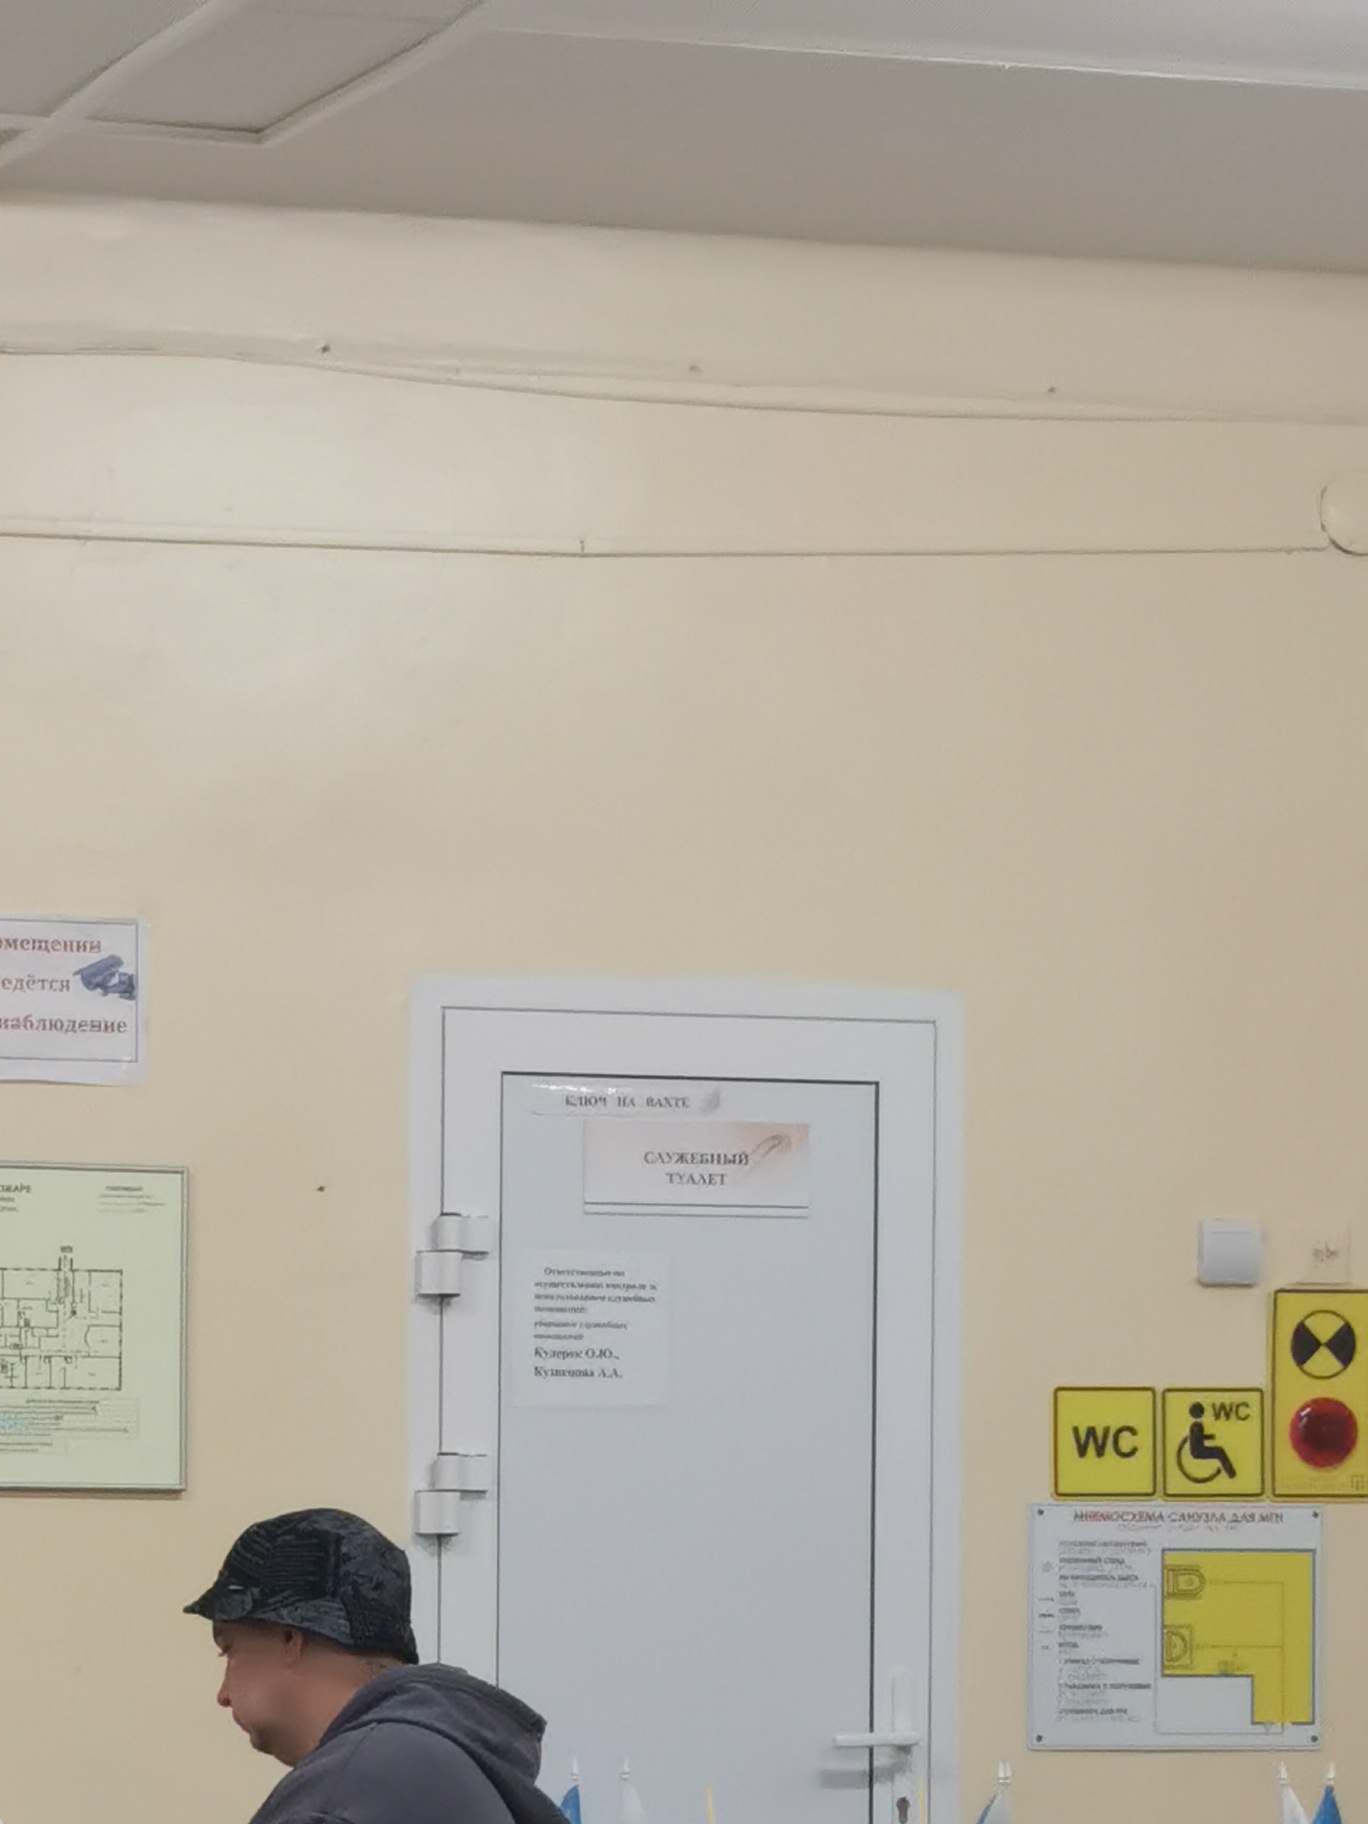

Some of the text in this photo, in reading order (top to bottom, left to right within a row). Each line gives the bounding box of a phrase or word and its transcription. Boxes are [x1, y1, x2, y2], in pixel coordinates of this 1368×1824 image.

[565, 1096, 608, 1108] КЛЮЧ
[617, 1096, 636, 1108] НА
[643, 1150, 750, 1167] СЛУЖЕБНЫЙ
[665, 1172, 728, 1187] ТУАЛЕТ
[1212, 1402, 1251, 1421] WC
[1072, 1425, 1139, 1458] WC
